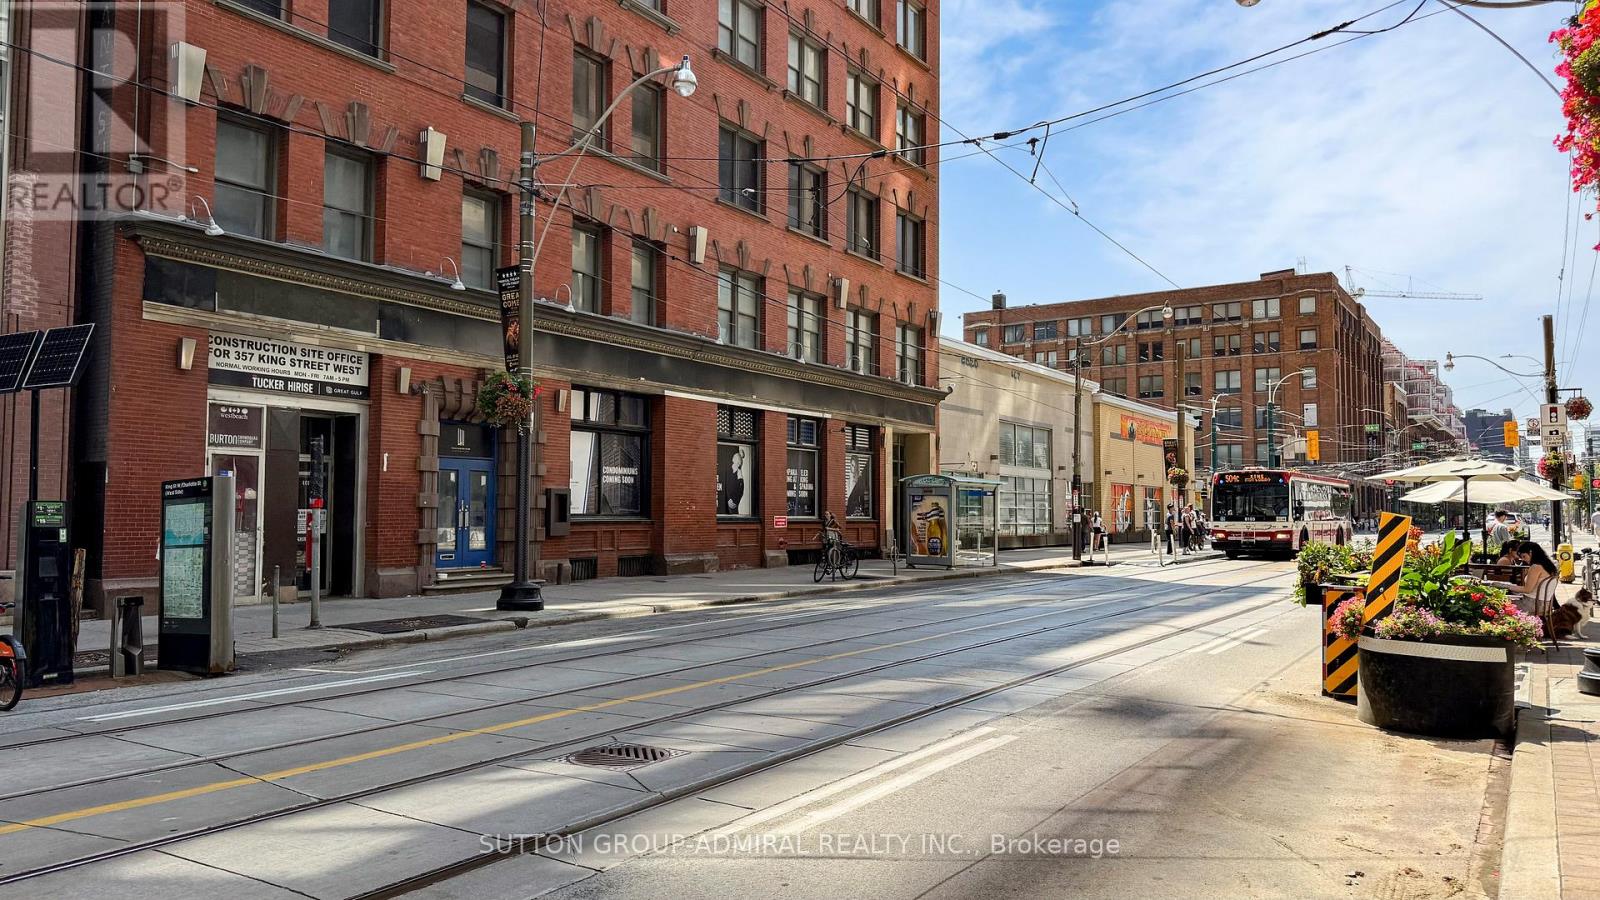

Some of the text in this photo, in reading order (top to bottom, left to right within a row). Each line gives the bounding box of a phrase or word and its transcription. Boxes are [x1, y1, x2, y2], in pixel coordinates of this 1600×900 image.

[501, 292, 520, 301] GREA
[502, 299, 520, 309] COME
[208, 335, 363, 365] CONSTRUCTION SITE OFFICE
[234, 350, 255, 362] 357
[258, 354, 286, 366] KING
[290, 358, 331, 372] STREET
[333, 364, 361, 376] WEST
[215, 361, 242, 370] NORMAL
[242, 364, 270, 373] WORKING
[271, 368, 291, 376] HOURS
[252, 376, 285, 391] TUCKER
[287, 380, 314, 394] HIRISE
[220, 412, 249, 420] westbeach
[602, 466, 638, 475] CONDOMINIUMS
[602, 475, 635, 484] COMING SOON
